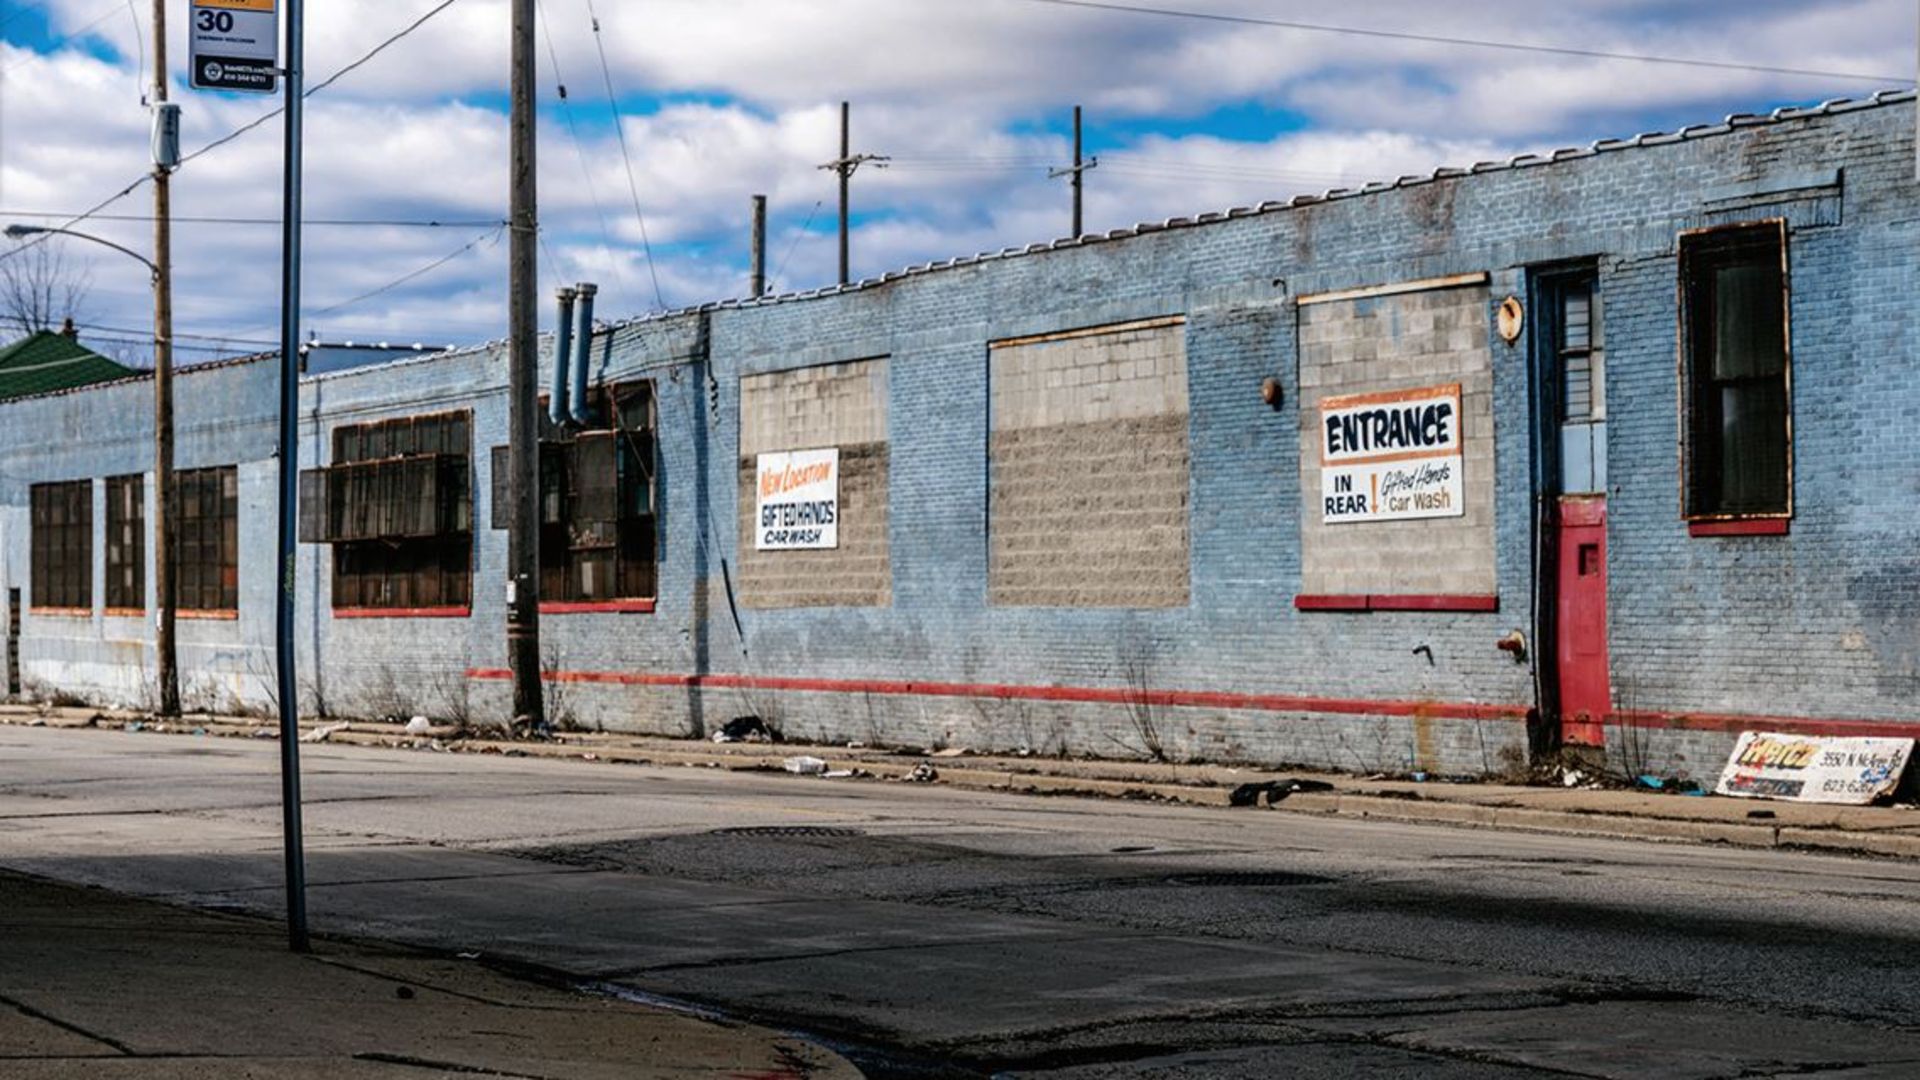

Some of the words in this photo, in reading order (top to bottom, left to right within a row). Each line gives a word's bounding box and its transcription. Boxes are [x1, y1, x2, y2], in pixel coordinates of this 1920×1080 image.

[197, 10, 234, 33] 30
[1326, 403, 1453, 454] ENTRANCE
[1334, 475, 1352, 493] IN
[1381, 467, 1418, 497] Gifted
[1415, 462, 1451, 490] Hands
[1325, 494, 1368, 516] REAR
[1413, 486, 1451, 511] Wash
[764, 530, 789, 545] CAR
[789, 528, 823, 544] WASH
